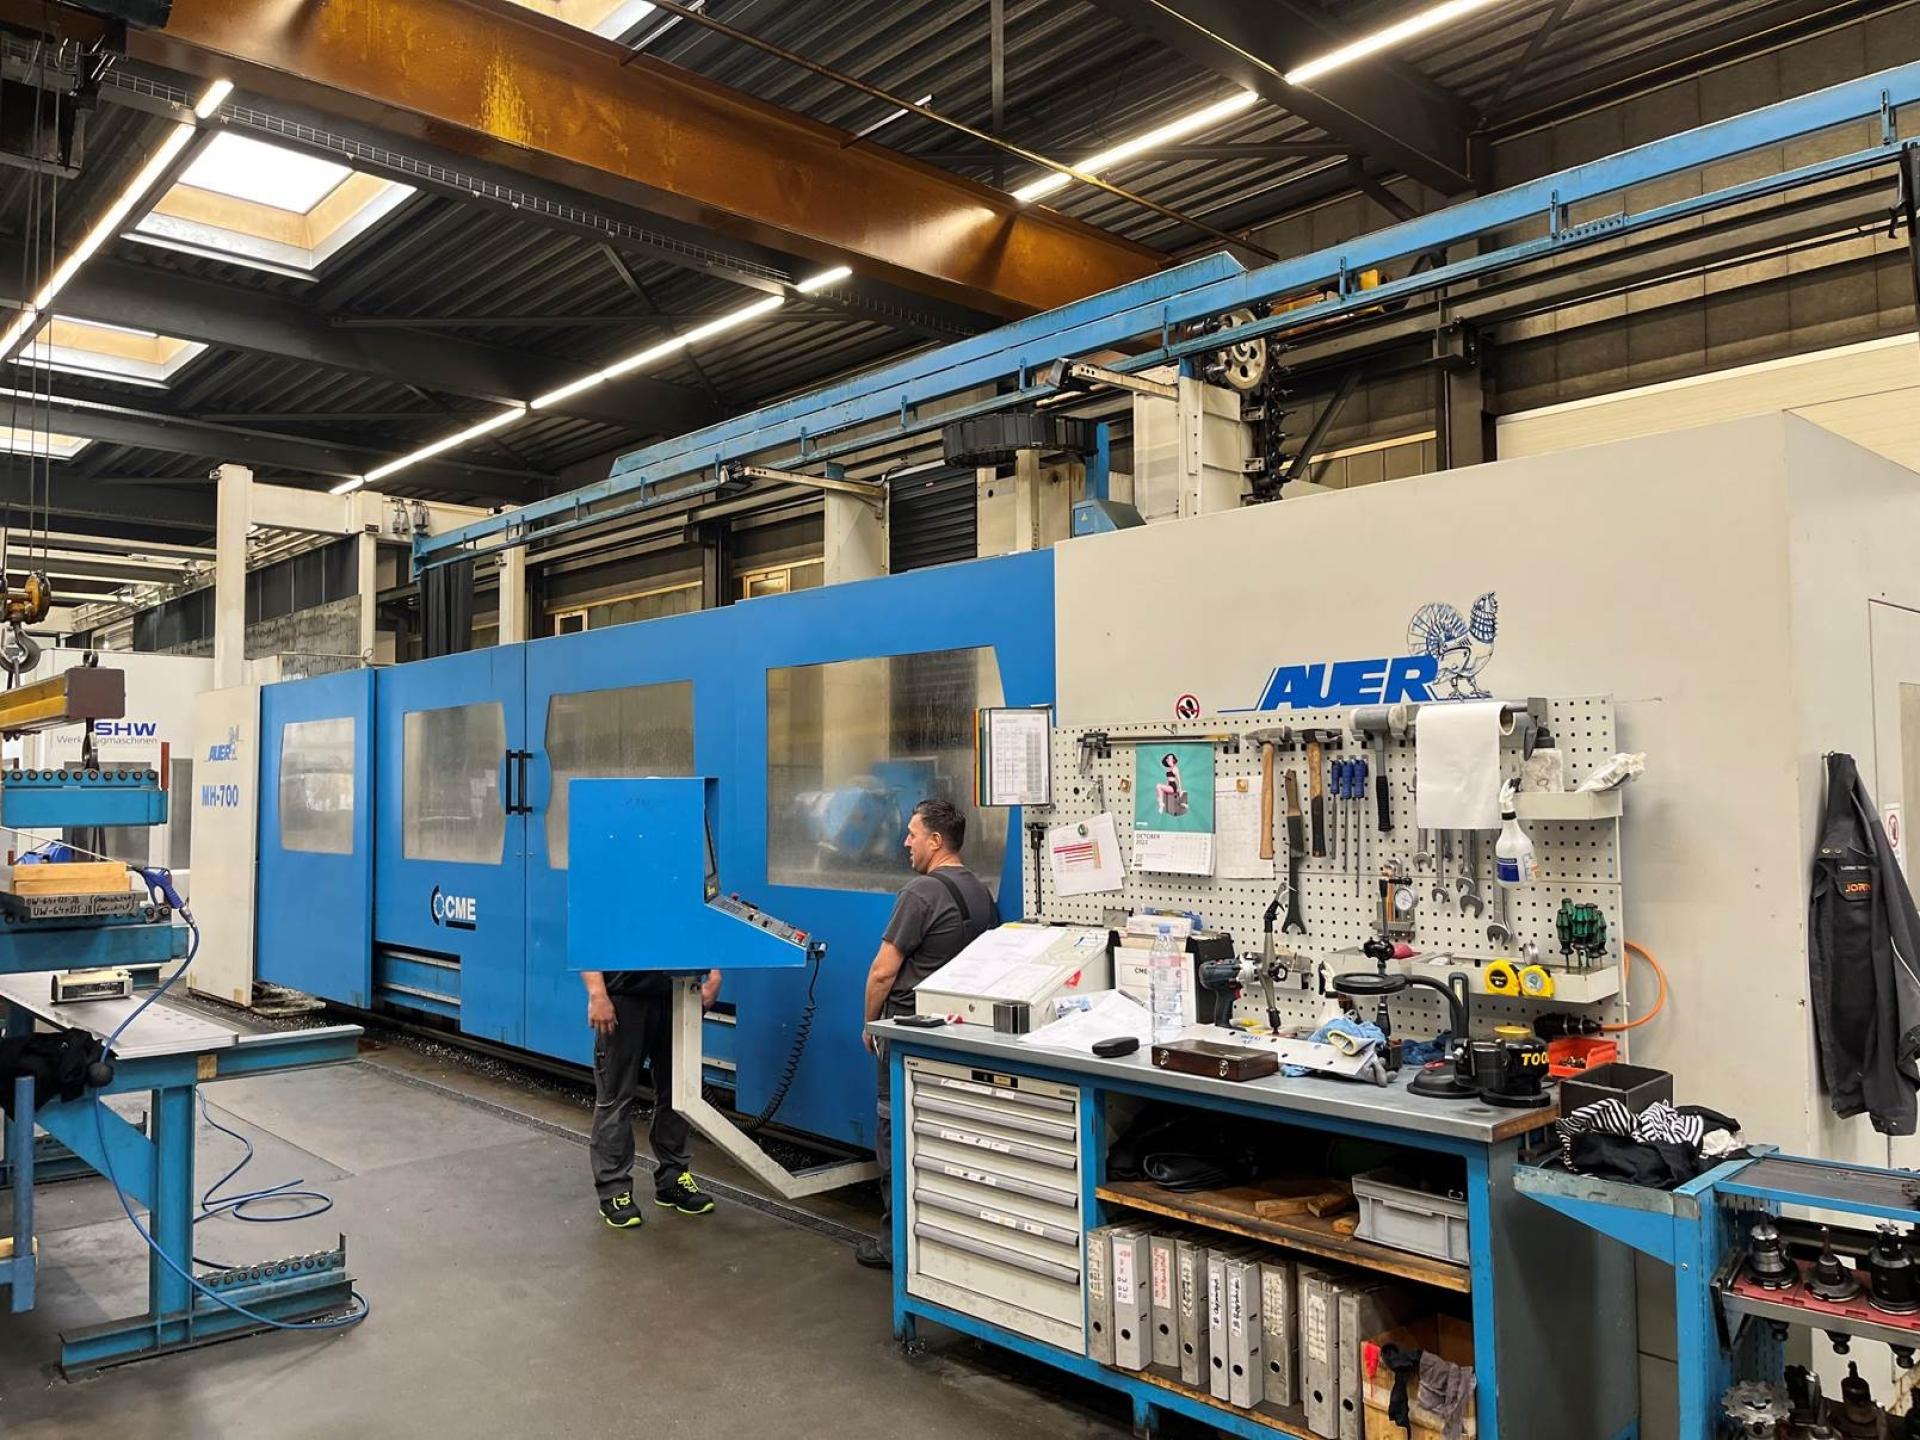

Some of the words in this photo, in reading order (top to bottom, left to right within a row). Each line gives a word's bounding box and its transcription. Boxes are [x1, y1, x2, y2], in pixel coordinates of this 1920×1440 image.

[1259, 654, 1439, 711] AUER
[95, 722, 156, 736] SHW
[202, 784, 239, 807] MH-700
[445, 895, 476, 921] CME
[1521, 1051, 1550, 1066] TOO
